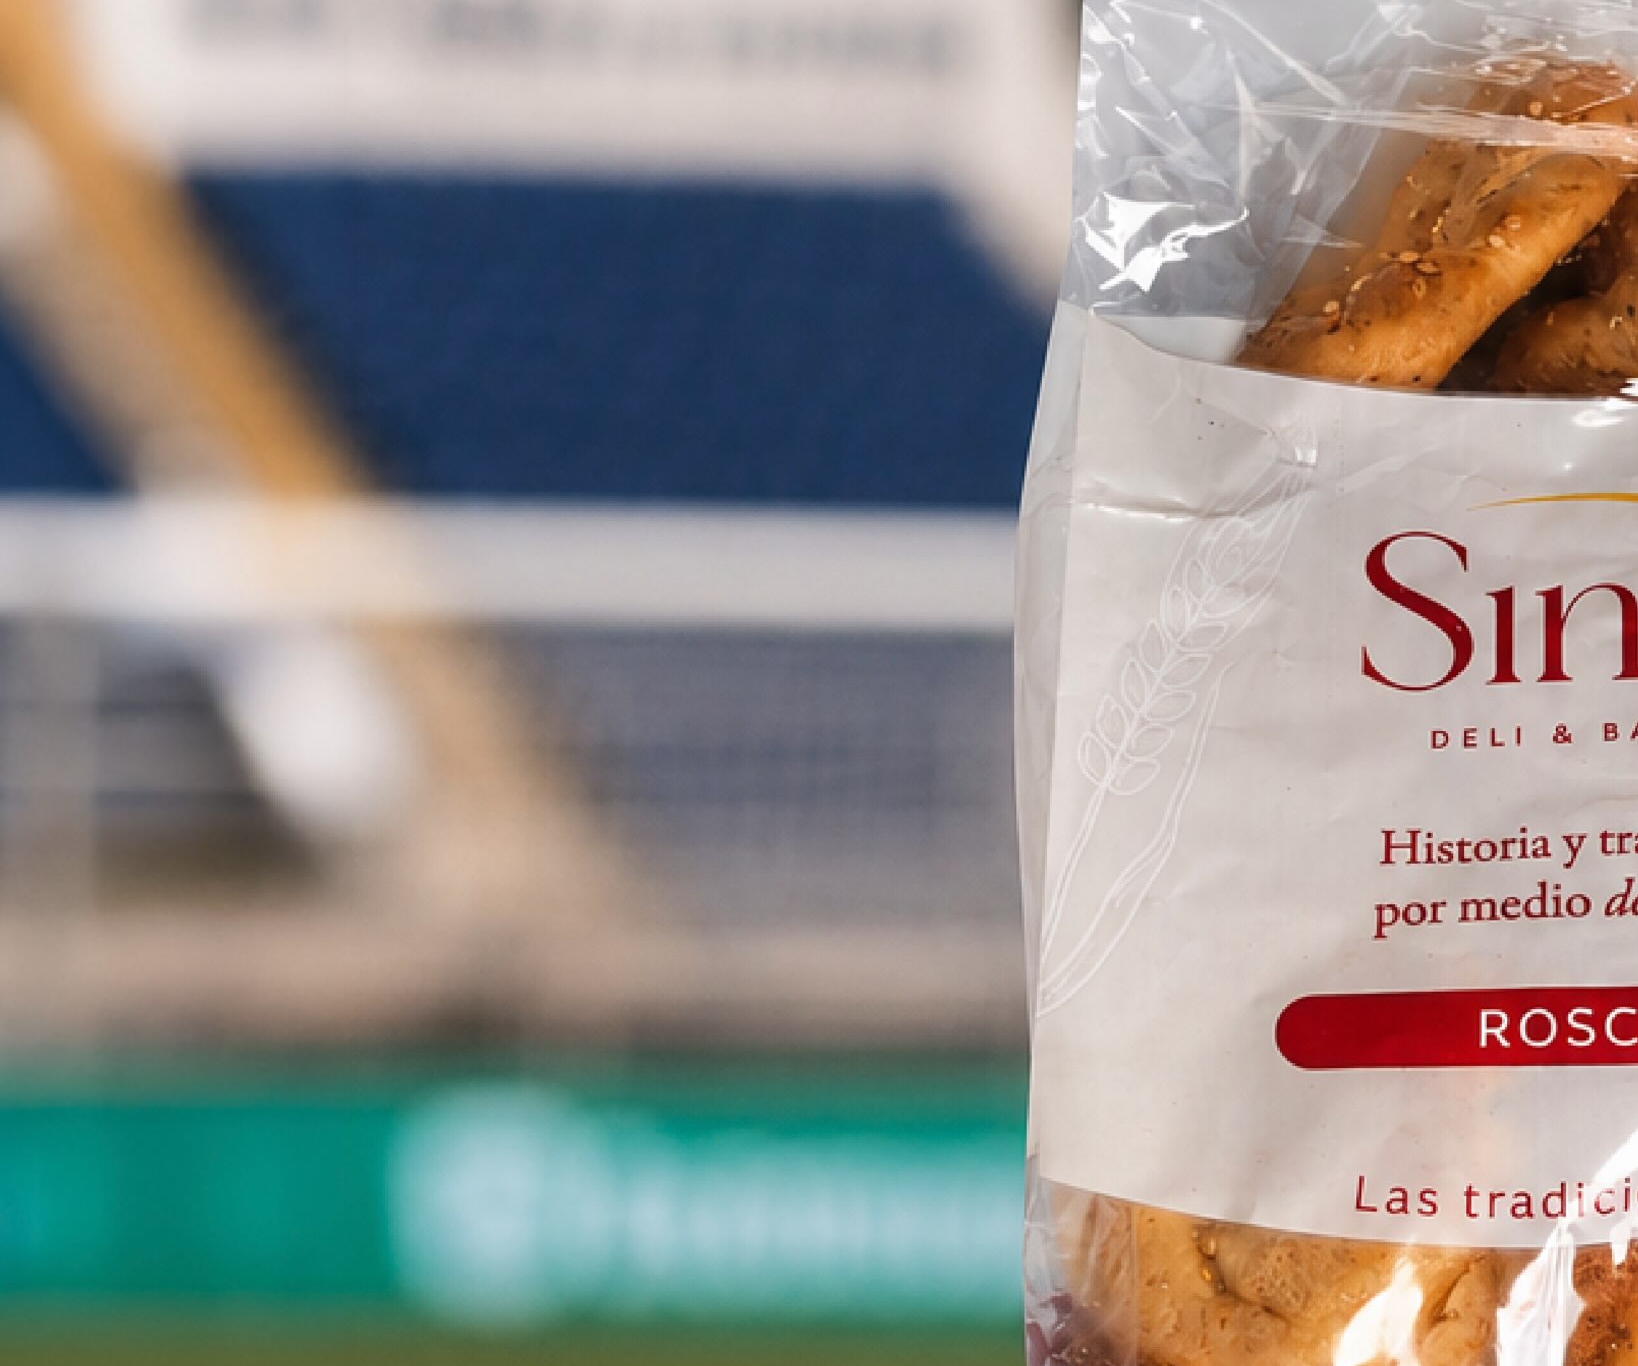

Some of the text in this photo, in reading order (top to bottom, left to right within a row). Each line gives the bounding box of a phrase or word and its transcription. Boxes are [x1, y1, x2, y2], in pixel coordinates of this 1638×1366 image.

[1431, 726, 1523, 750] DELI
[1552, 724, 1573, 744] &
[1379, 826, 1552, 866] Historia
[1561, 832, 1587, 869] y
[1373, 894, 1447, 938] por
[1458, 881, 1592, 924] medio
[1355, 1175, 1439, 1218] Las
